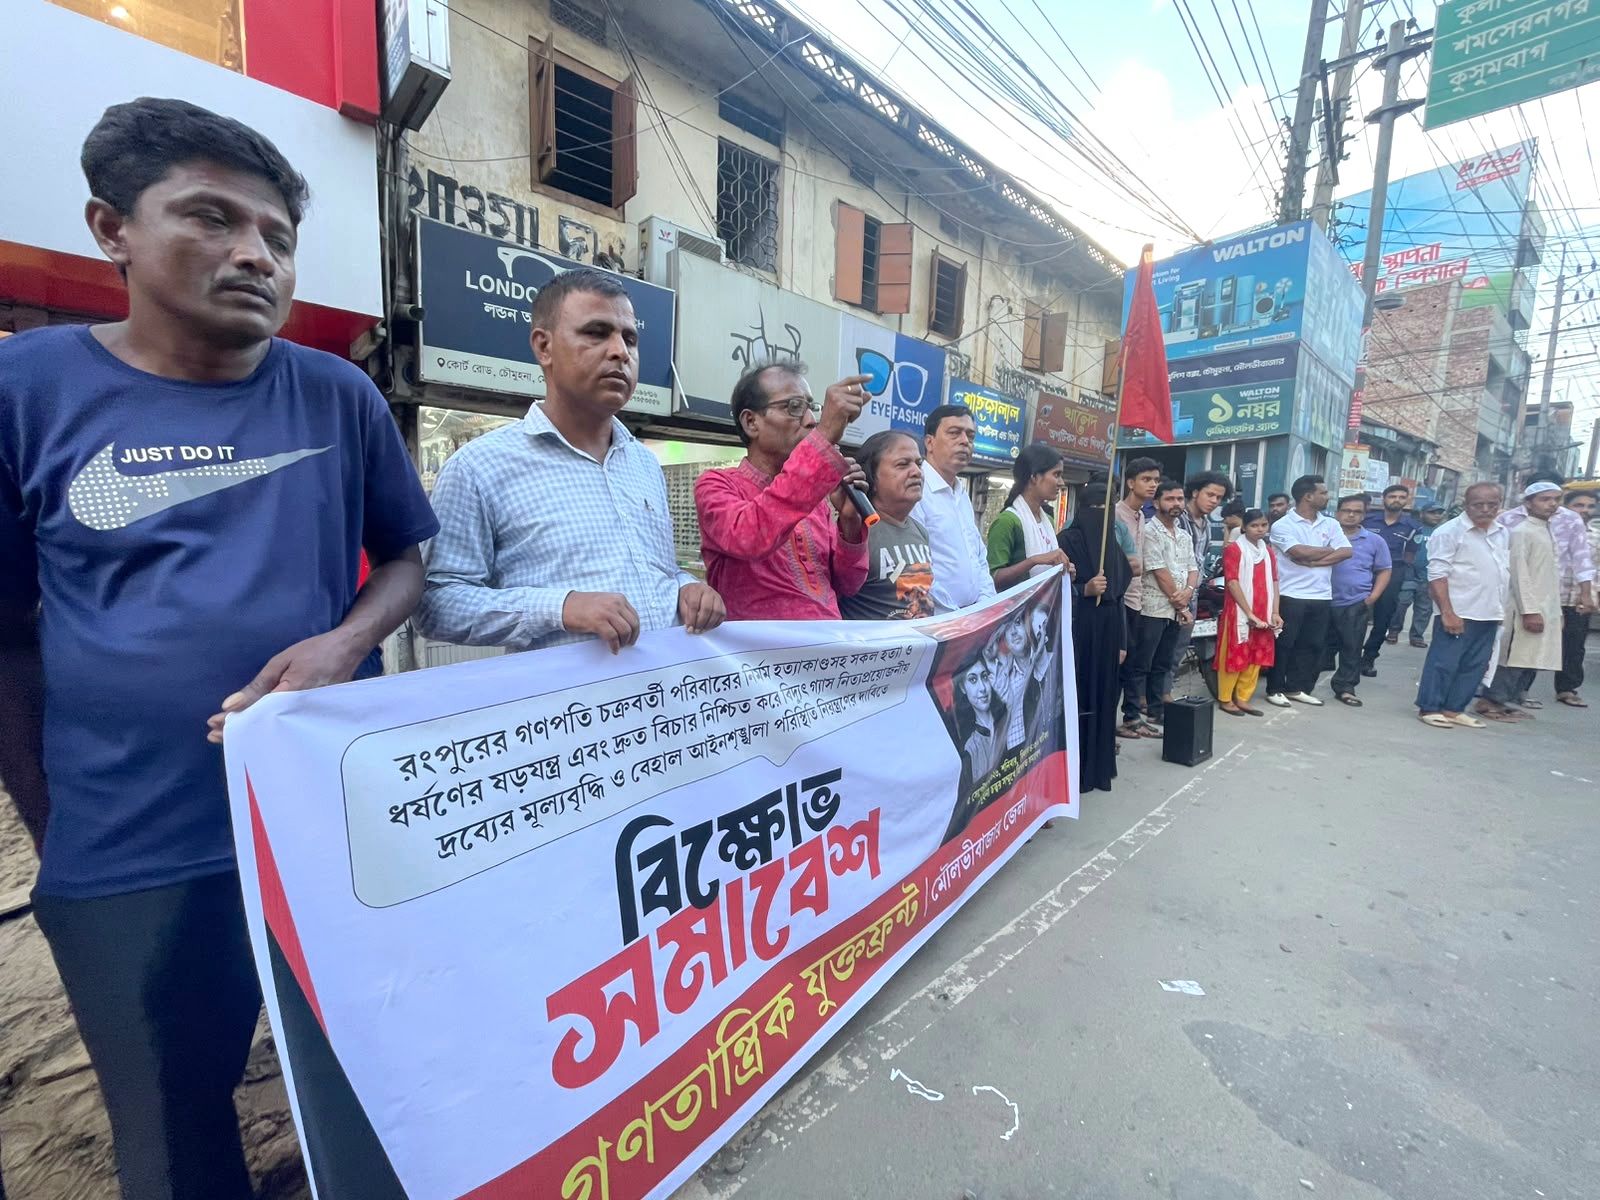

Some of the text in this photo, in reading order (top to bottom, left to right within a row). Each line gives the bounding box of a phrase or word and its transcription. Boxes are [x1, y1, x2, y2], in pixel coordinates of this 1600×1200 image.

[1453, 0, 1590, 54] শমসেরনগর
[1448, 41, 1550, 92] কুসুমবাগ
[1474, 147, 1523, 173] Fresh
[1212, 227, 1305, 262] WALTON
[1382, 242, 1442, 274] স্থাপনা
[465, 270, 538, 303] LONDO
[1395, 258, 1470, 288] স্পেশাল
[483, 302, 518, 323] লন্ডন
[446, 359, 469, 372] কোর্ট
[472, 364, 496, 377] রোড,
[499, 366, 536, 383] চৌমুহনা,
[1233, 357, 1285, 372] মৌলভীবাজার
[1208, 393, 1281, 423] ১ নম্বর
[1239, 386, 1280, 398] WALTON
[870, 400, 929, 426] EYE FASHIO
[120, 445, 235, 464] JUST DO IT
[393, 645, 913, 782] রংপুরের গণপতি চক্রবর্তী পরিবারের নির্মম হত্যাকাণ্ডসহ সকল হত্যা ও
[389, 660, 911, 828] ধর্ষণের ষড়যন্ত্র এবং দ্রুত বিচার নিশ্চিত করে বিদ্যুৎ গ্যাস নিত্যপ্রয়োজনীয়
[435, 683, 890, 860] দ্রব্যের মূল্যবৃদ্ধি ও বেহাল আইনশৃঙ্খলা পরিস্থিতি নিয়ন্ত্রণের দাবিতে
[614, 767, 842, 947] বিক্ষোভ
[545, 807, 882, 1089] সমাবেশ
[560, 794, 1028, 1200] গণতান্ত্রিক যুক্তফ্রন্ট মৌলভীবাজার জেলা
